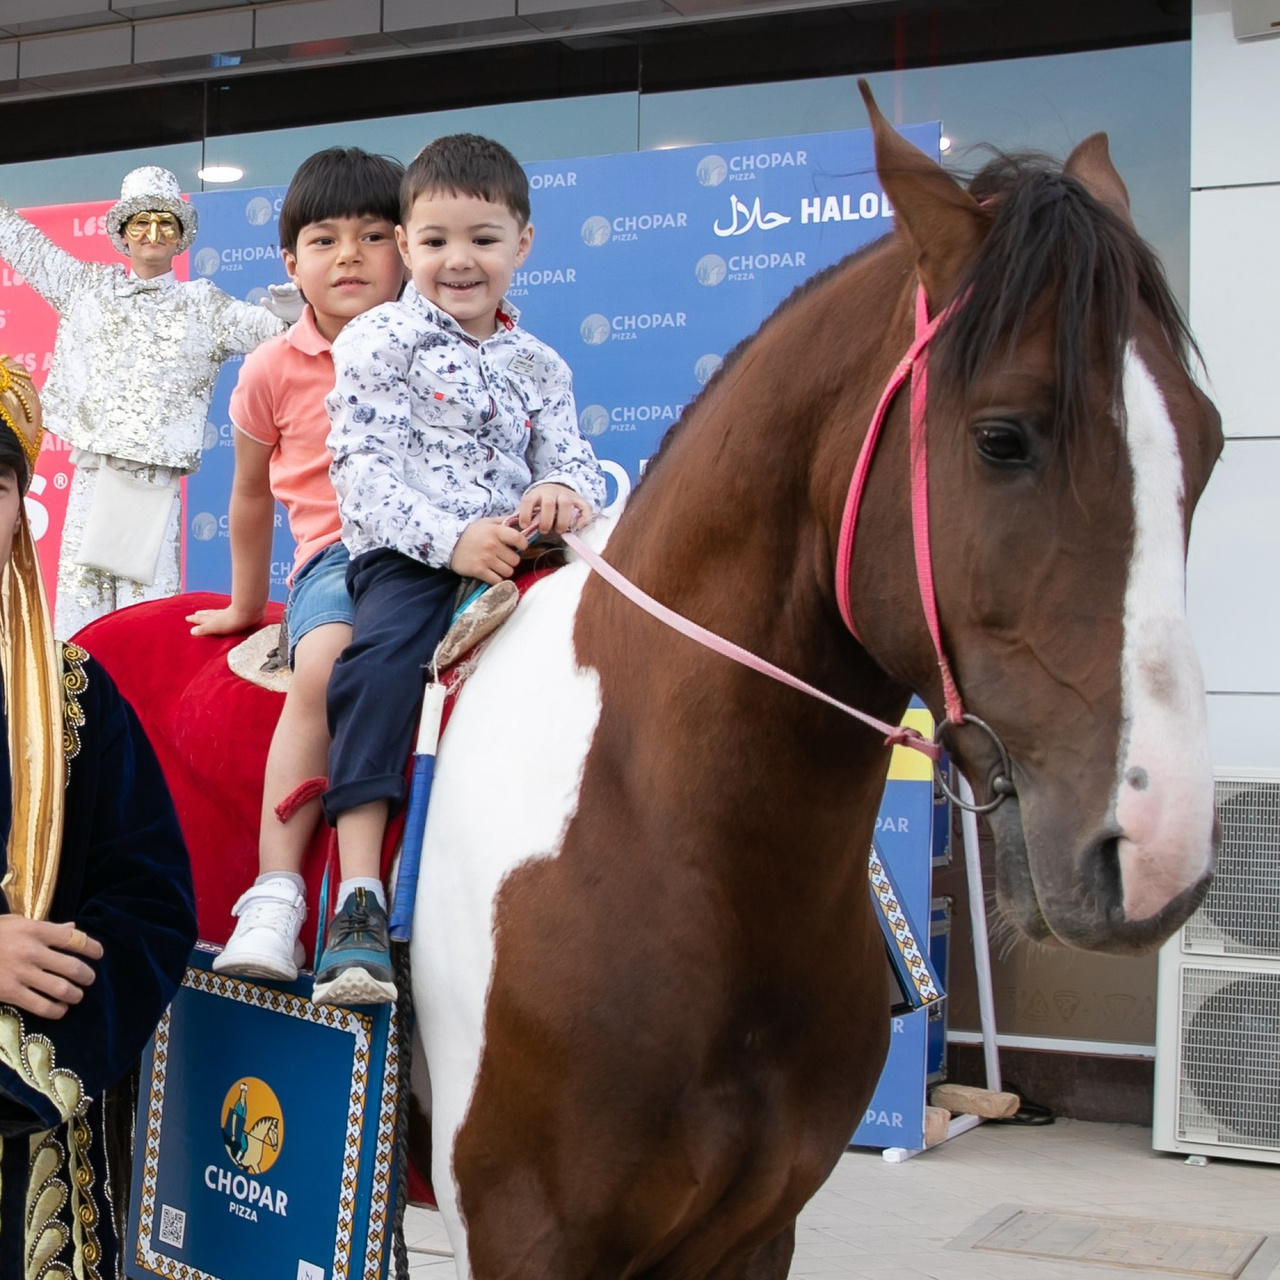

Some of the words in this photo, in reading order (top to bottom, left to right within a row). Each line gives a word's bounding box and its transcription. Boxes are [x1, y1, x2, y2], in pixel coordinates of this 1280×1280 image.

[729, 151, 807, 170] CHOPAR
[729, 173, 756, 181] PIZZA
[713, 194, 791, 237] حلال
[801, 192, 895, 224] HALOL
[612, 213, 688, 232] CHOPAR
[612, 234, 638, 242] PIZZA
[728, 251, 806, 271] CHOPAR
[728, 272, 755, 281] PIZZA
[612, 312, 687, 331] CHOPAR
[612, 332, 637, 340] PIZZA
[611, 424, 637, 432] PIZZA
[204, 1164, 288, 1216] CHOPAR
[229, 1201, 258, 1223] PIZZA
